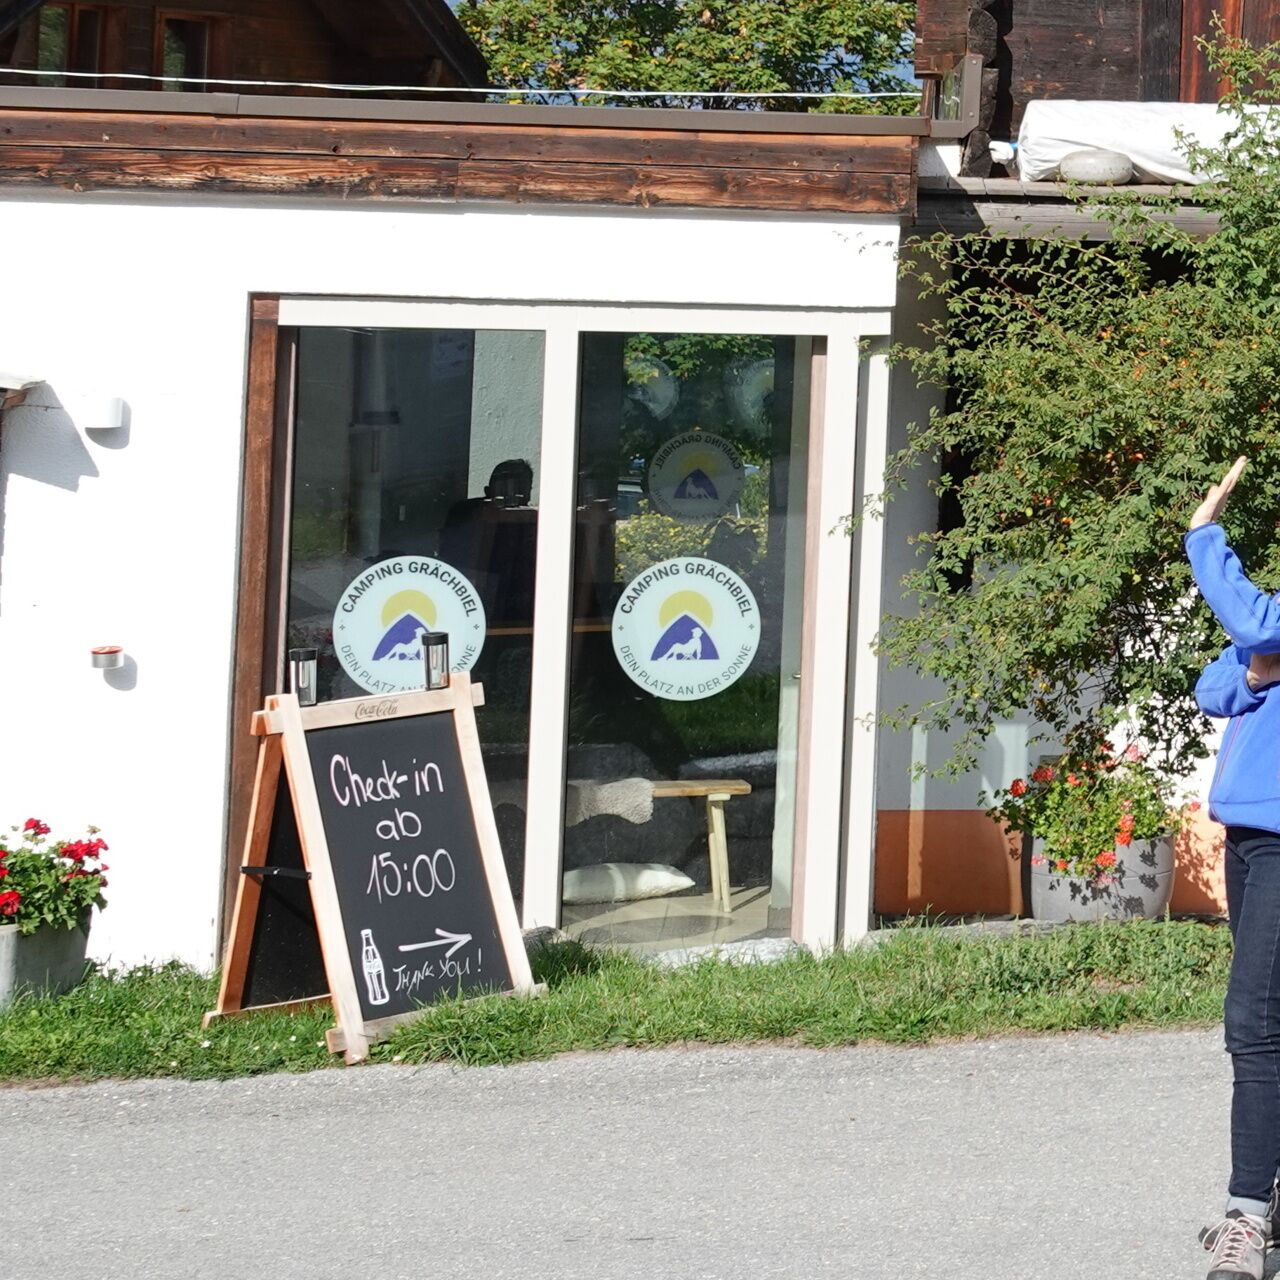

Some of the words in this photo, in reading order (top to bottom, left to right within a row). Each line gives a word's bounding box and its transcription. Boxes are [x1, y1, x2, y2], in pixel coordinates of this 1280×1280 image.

[342, 562, 403, 613] CAMPING
[408, 561, 478, 617] GRÄCHBIEL
[620, 563, 680, 614] CAMPING
[684, 562, 752, 617] GRÄCHBIEL
[341, 644, 361, 672] DEIN
[358, 671, 396, 693] PLATZ
[620, 645, 640, 672] DEIN
[638, 671, 674, 695] PLATZ
[676, 686, 694, 695] AN
[697, 677, 722, 694] DER
[721, 643, 752, 681] SONNE
[330, 754, 444, 807] Check-in
[376, 808, 422, 840] ab
[366, 848, 456, 904] 15:00
